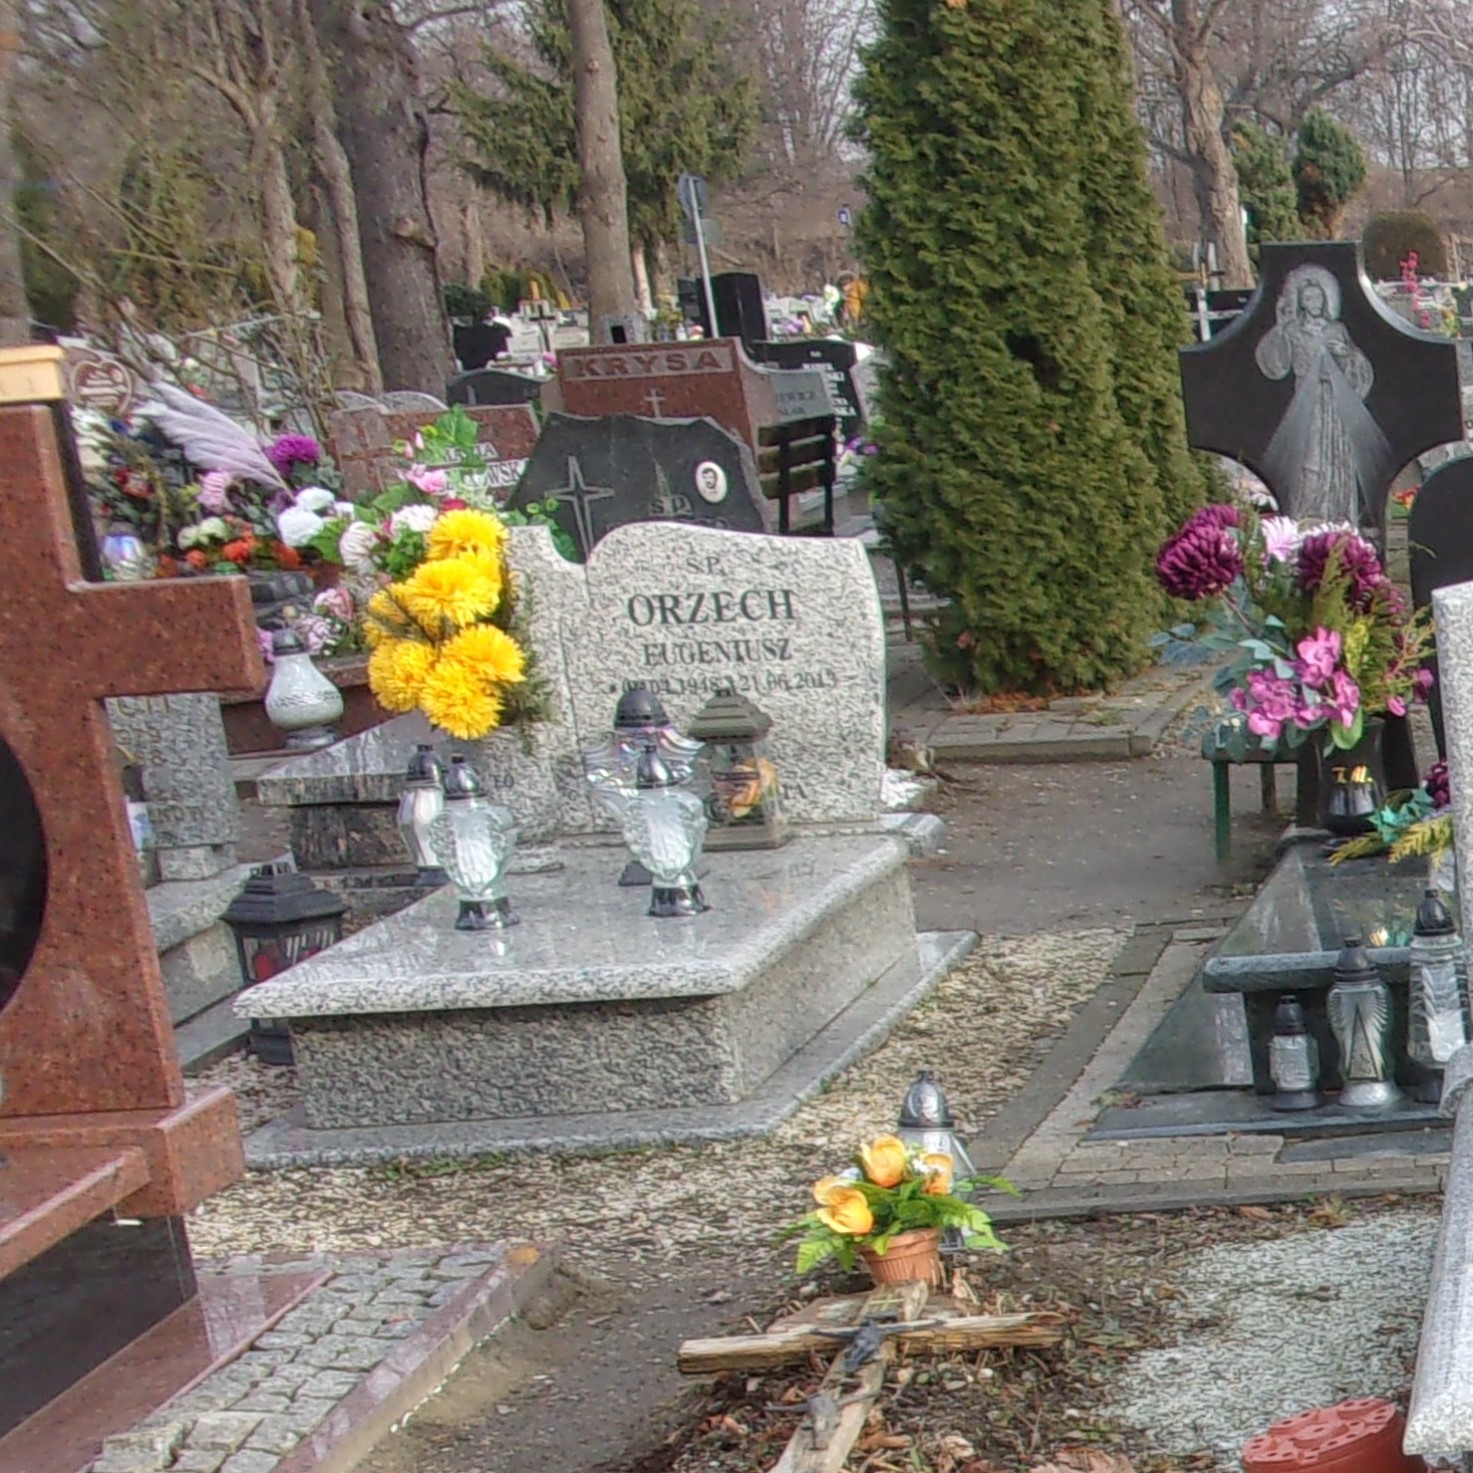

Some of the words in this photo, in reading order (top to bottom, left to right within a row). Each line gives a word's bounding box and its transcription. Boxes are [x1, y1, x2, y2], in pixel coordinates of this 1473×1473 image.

[575, 350, 725, 378] KRYSA
[627, 588, 798, 627] ORZECH
[642, 637, 793, 668] EUGENIUSZ
